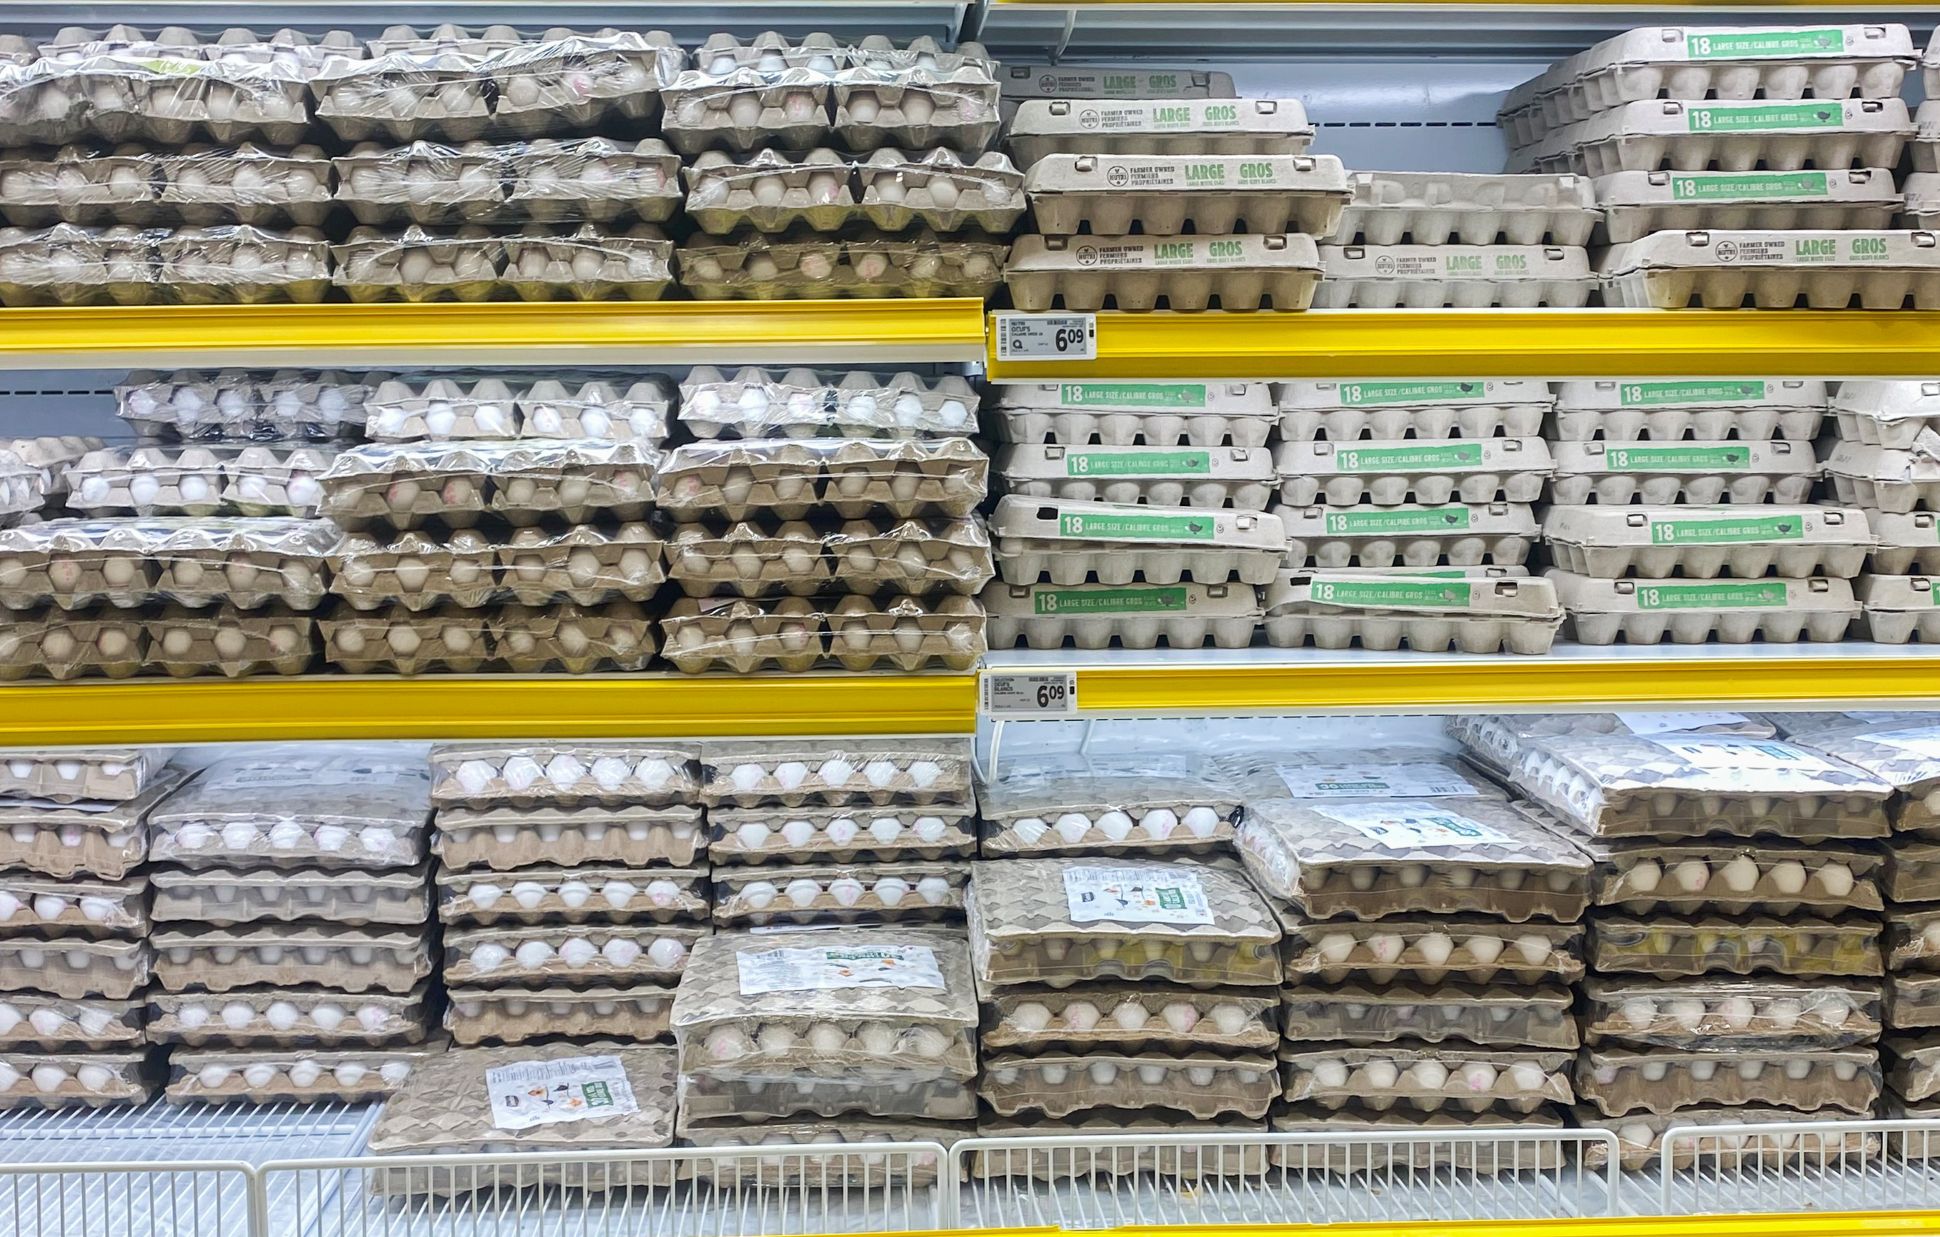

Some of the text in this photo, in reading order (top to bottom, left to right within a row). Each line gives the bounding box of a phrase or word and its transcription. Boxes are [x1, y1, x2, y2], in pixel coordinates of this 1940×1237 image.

[1692, 38, 1710, 54] 18
[1104, 75, 1176, 89] LARGE GROS
[1153, 105, 1237, 122] LARGE GROS
[1693, 111, 1711, 128] 18
[1185, 163, 1273, 180] LARGE GROS
[1677, 180, 1695, 196] 18
[1154, 241, 1243, 259] LARGE GROS
[1796, 238, 1887, 255] LARGE GROS
[1446, 255, 1526, 270] LARGE GROS
[1066, 386, 1082, 401] 18
[1344, 386, 1361, 402] 18
[1625, 386, 1641, 402] 18
[1072, 456, 1088, 472] 18
[1341, 452, 1358, 468] 18
[1611, 451, 1628, 467] 18
[1065, 517, 1082, 533] 18
[1330, 515, 1347, 531] 18
[1656, 524, 1674, 541] 18
[1317, 584, 1334, 599] 18
[1641, 589, 1659, 606] 18
[1039, 594, 1057, 611] 18
